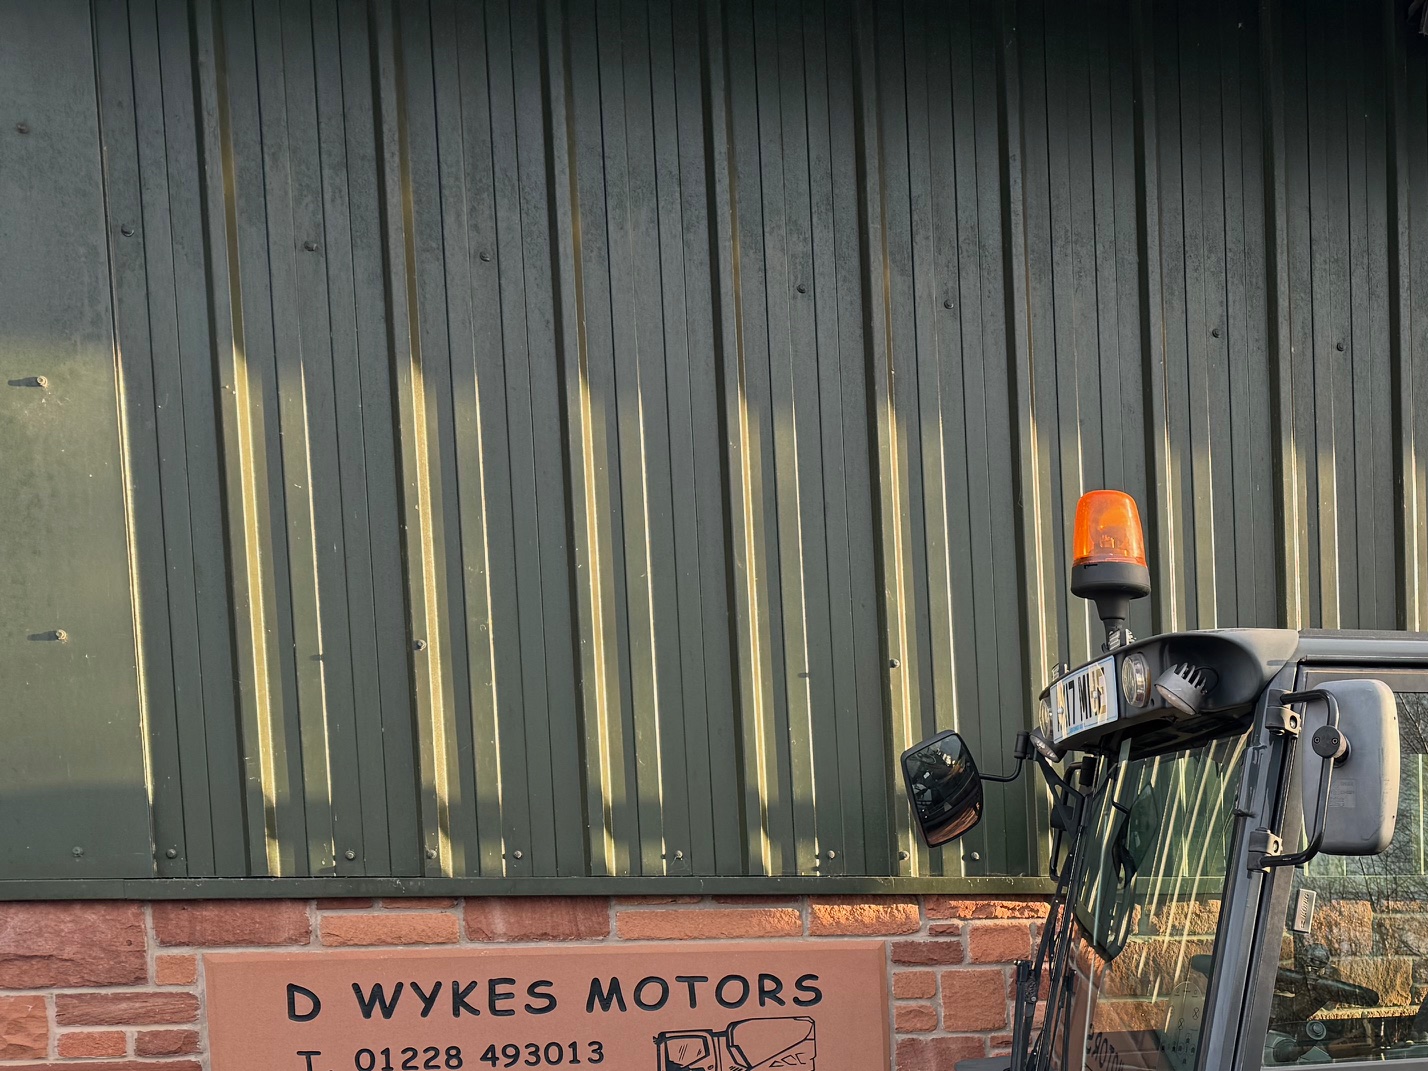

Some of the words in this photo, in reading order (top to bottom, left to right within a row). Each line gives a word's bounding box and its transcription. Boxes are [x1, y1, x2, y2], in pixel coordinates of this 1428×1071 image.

[286, 982, 322, 1022] D
[352, 978, 558, 1019] WYKES
[586, 973, 823, 1013] MOTORS
[355, 1046, 463, 1071] 01228
[480, 1041, 605, 1068] 493013
